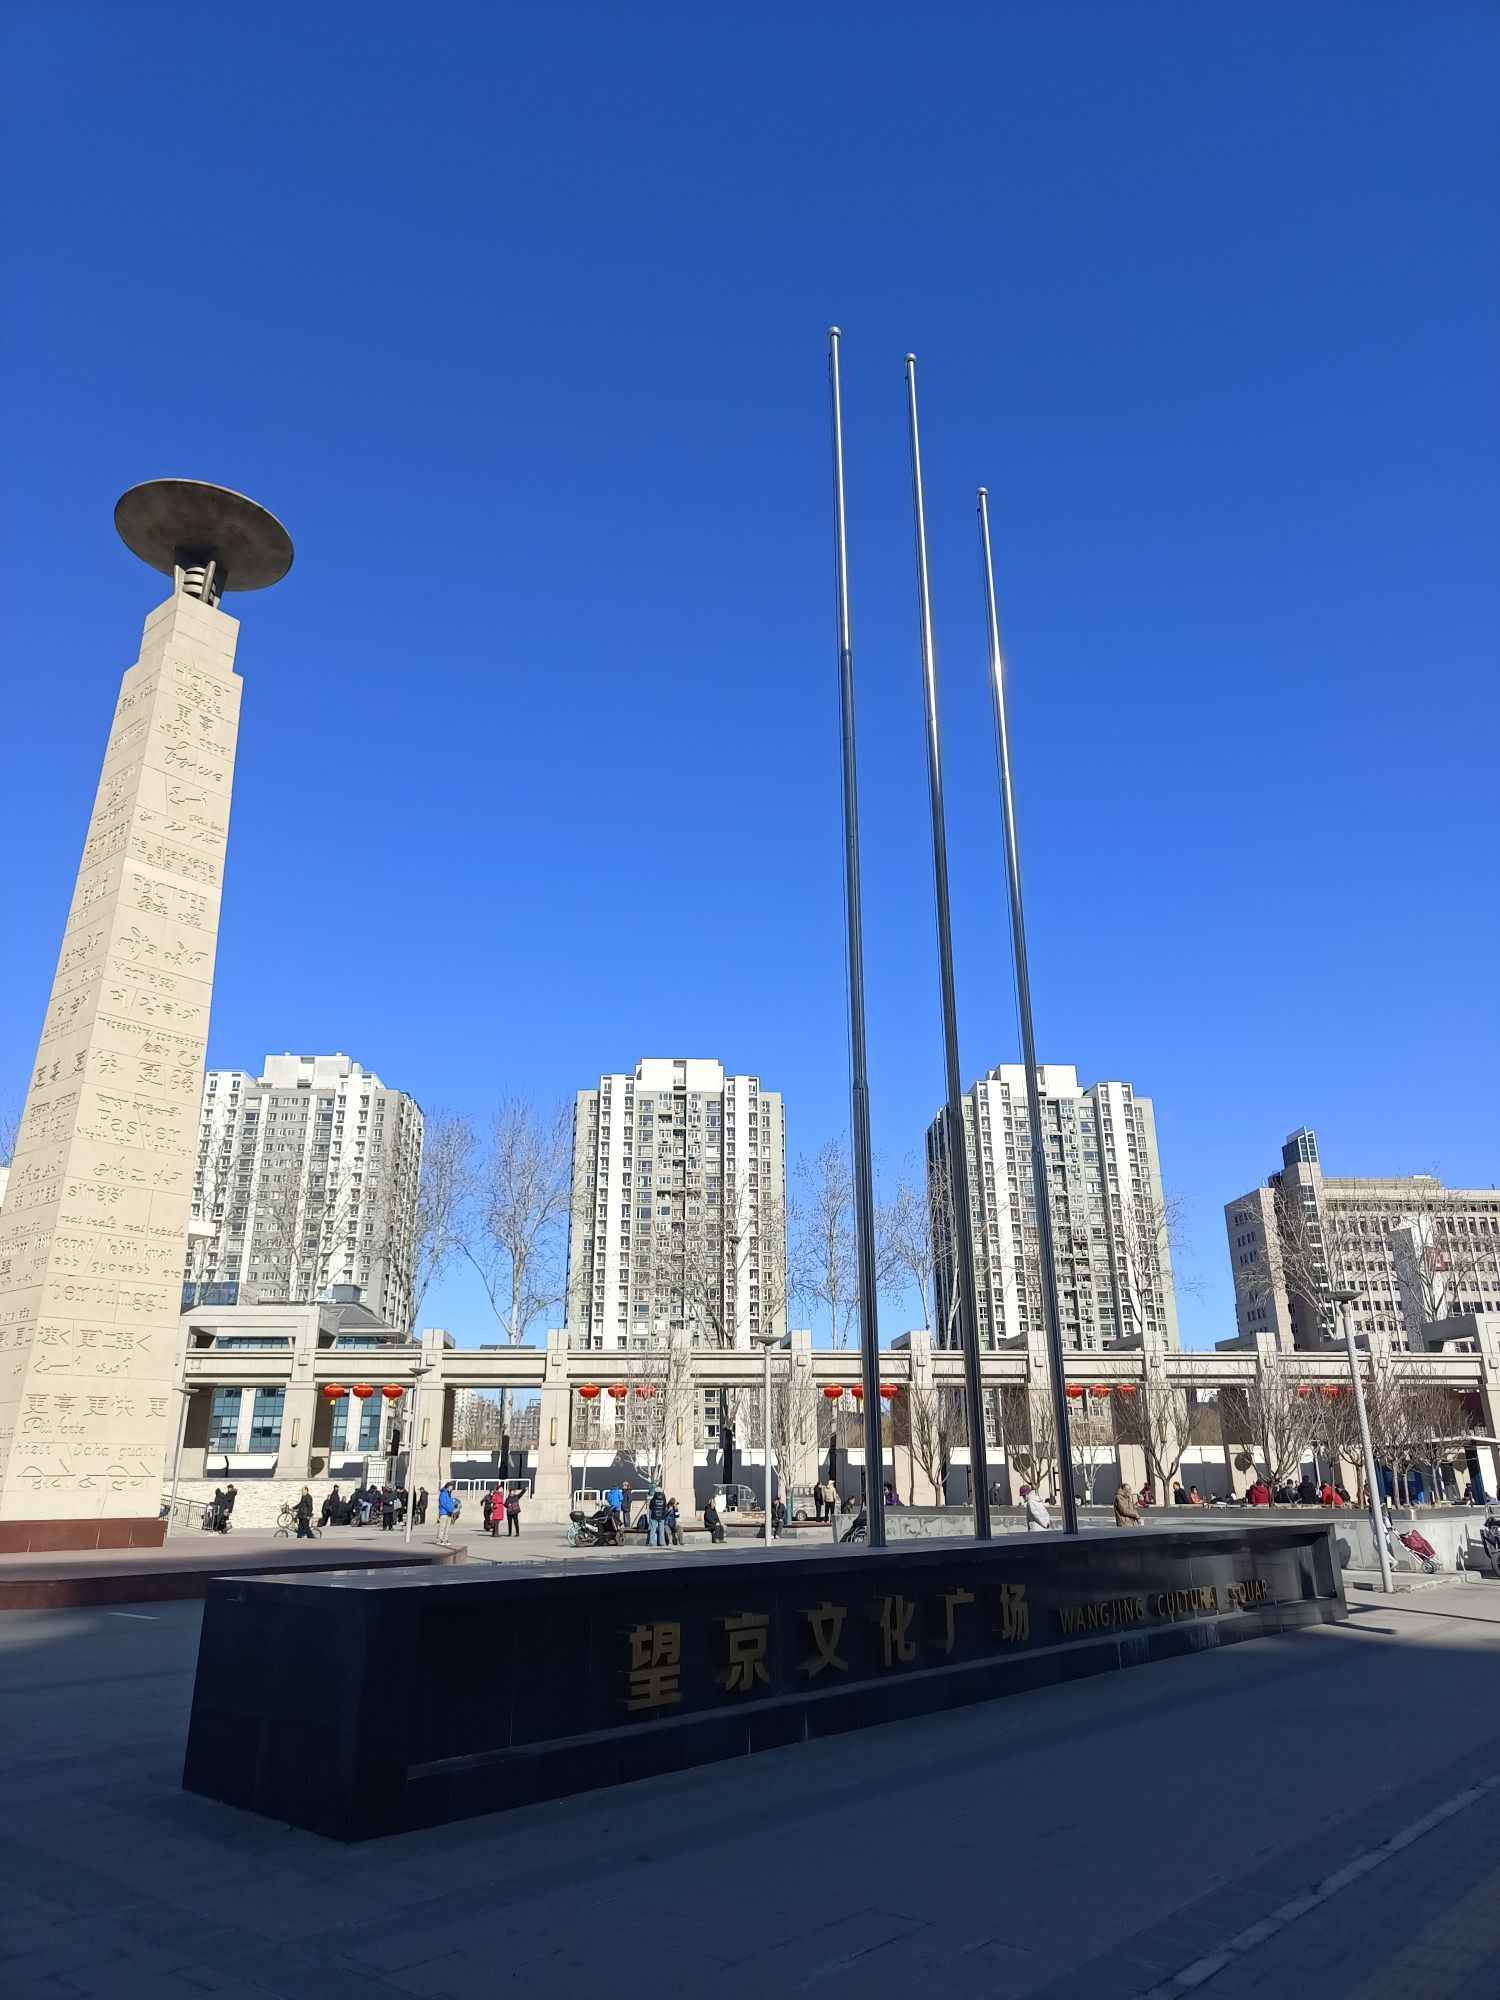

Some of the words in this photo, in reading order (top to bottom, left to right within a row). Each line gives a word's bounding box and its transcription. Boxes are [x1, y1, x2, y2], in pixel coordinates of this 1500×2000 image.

[174, 662, 231, 700] Higher
[132, 873, 208, 913] БЫСТРЕЕ
[95, 1108, 182, 1143] Faster
[107, 1238, 137, 1258] lebih
[48, 1280, 168, 1312] tertinggi
[1060, 1598, 1145, 1634] WANGJING
[627, 1583, 1030, 1711] 望京文化广场
